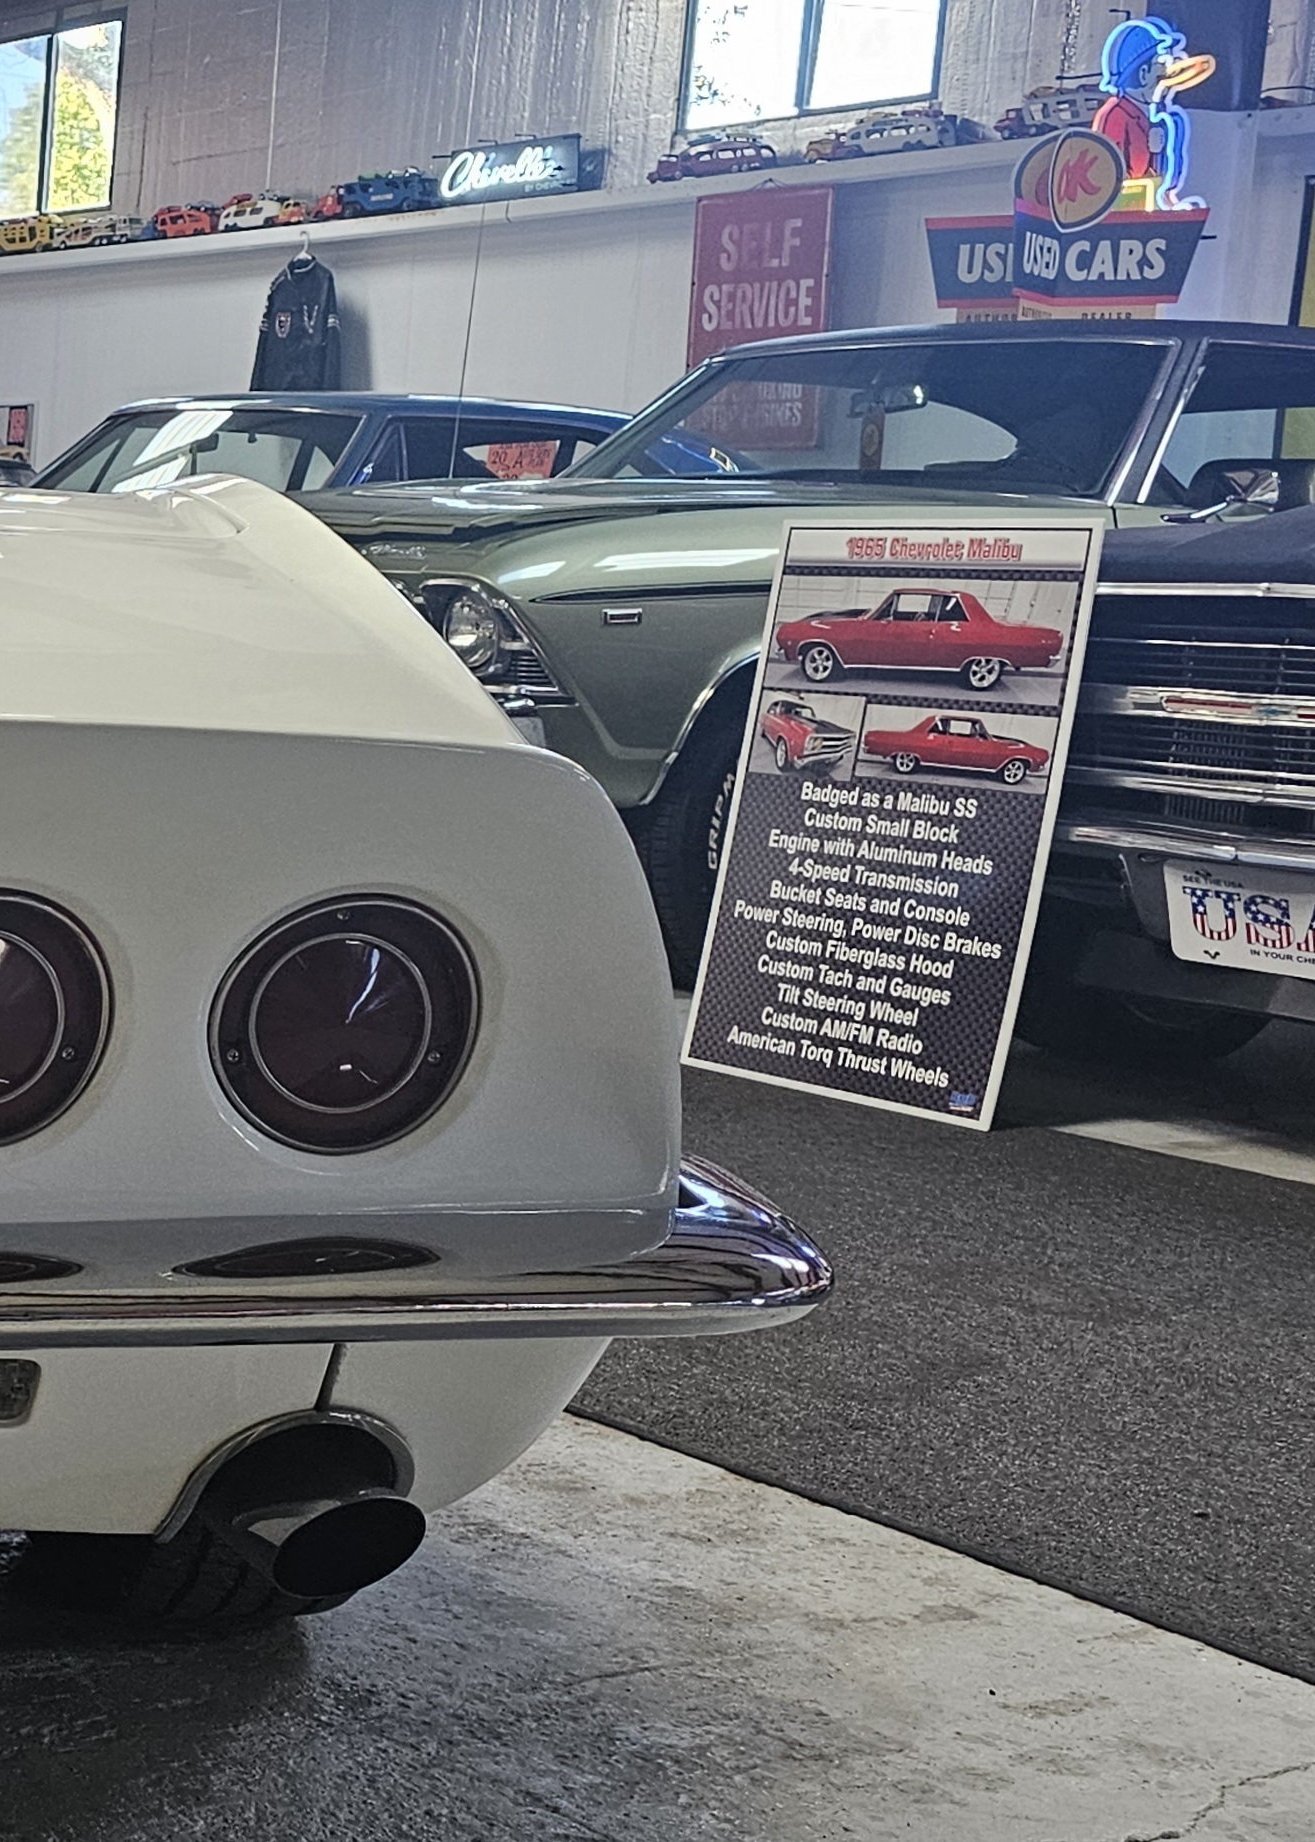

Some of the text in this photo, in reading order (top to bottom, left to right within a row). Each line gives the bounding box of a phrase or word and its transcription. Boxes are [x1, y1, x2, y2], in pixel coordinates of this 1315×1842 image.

[719, 217, 803, 272] SELF
[1023, 230, 1167, 282] USED CARS
[701, 278, 815, 332] SERVICE
[846, 537, 1024, 562] 1965 Chevrolet Malibu
[801, 781, 979, 819] Badged as a Malibu SS
[804, 807, 960, 845] Custom Small Block
[768, 828, 994, 876] Engine with Aluminum Heads
[788, 857, 960, 899] 4-Speed Transmission
[770, 879, 971, 927] Bucket Seats and Console
[733, 900, 1003, 960] Power Steering, Power Disc Brakes
[765, 930, 955, 979] Custom Fiberglass Hood
[1250, 948, 1261, 957] IN
[1263, 950, 1294, 962] YOUR
[757, 954, 952, 1008] Custom Tach and Gauges
[777, 982, 920, 1027] Tilt Steering Wheel
[760, 1005, 924, 1055] Custom AM/FM Radio
[727, 1025, 951, 1088] American Torq Thrust Wheels
